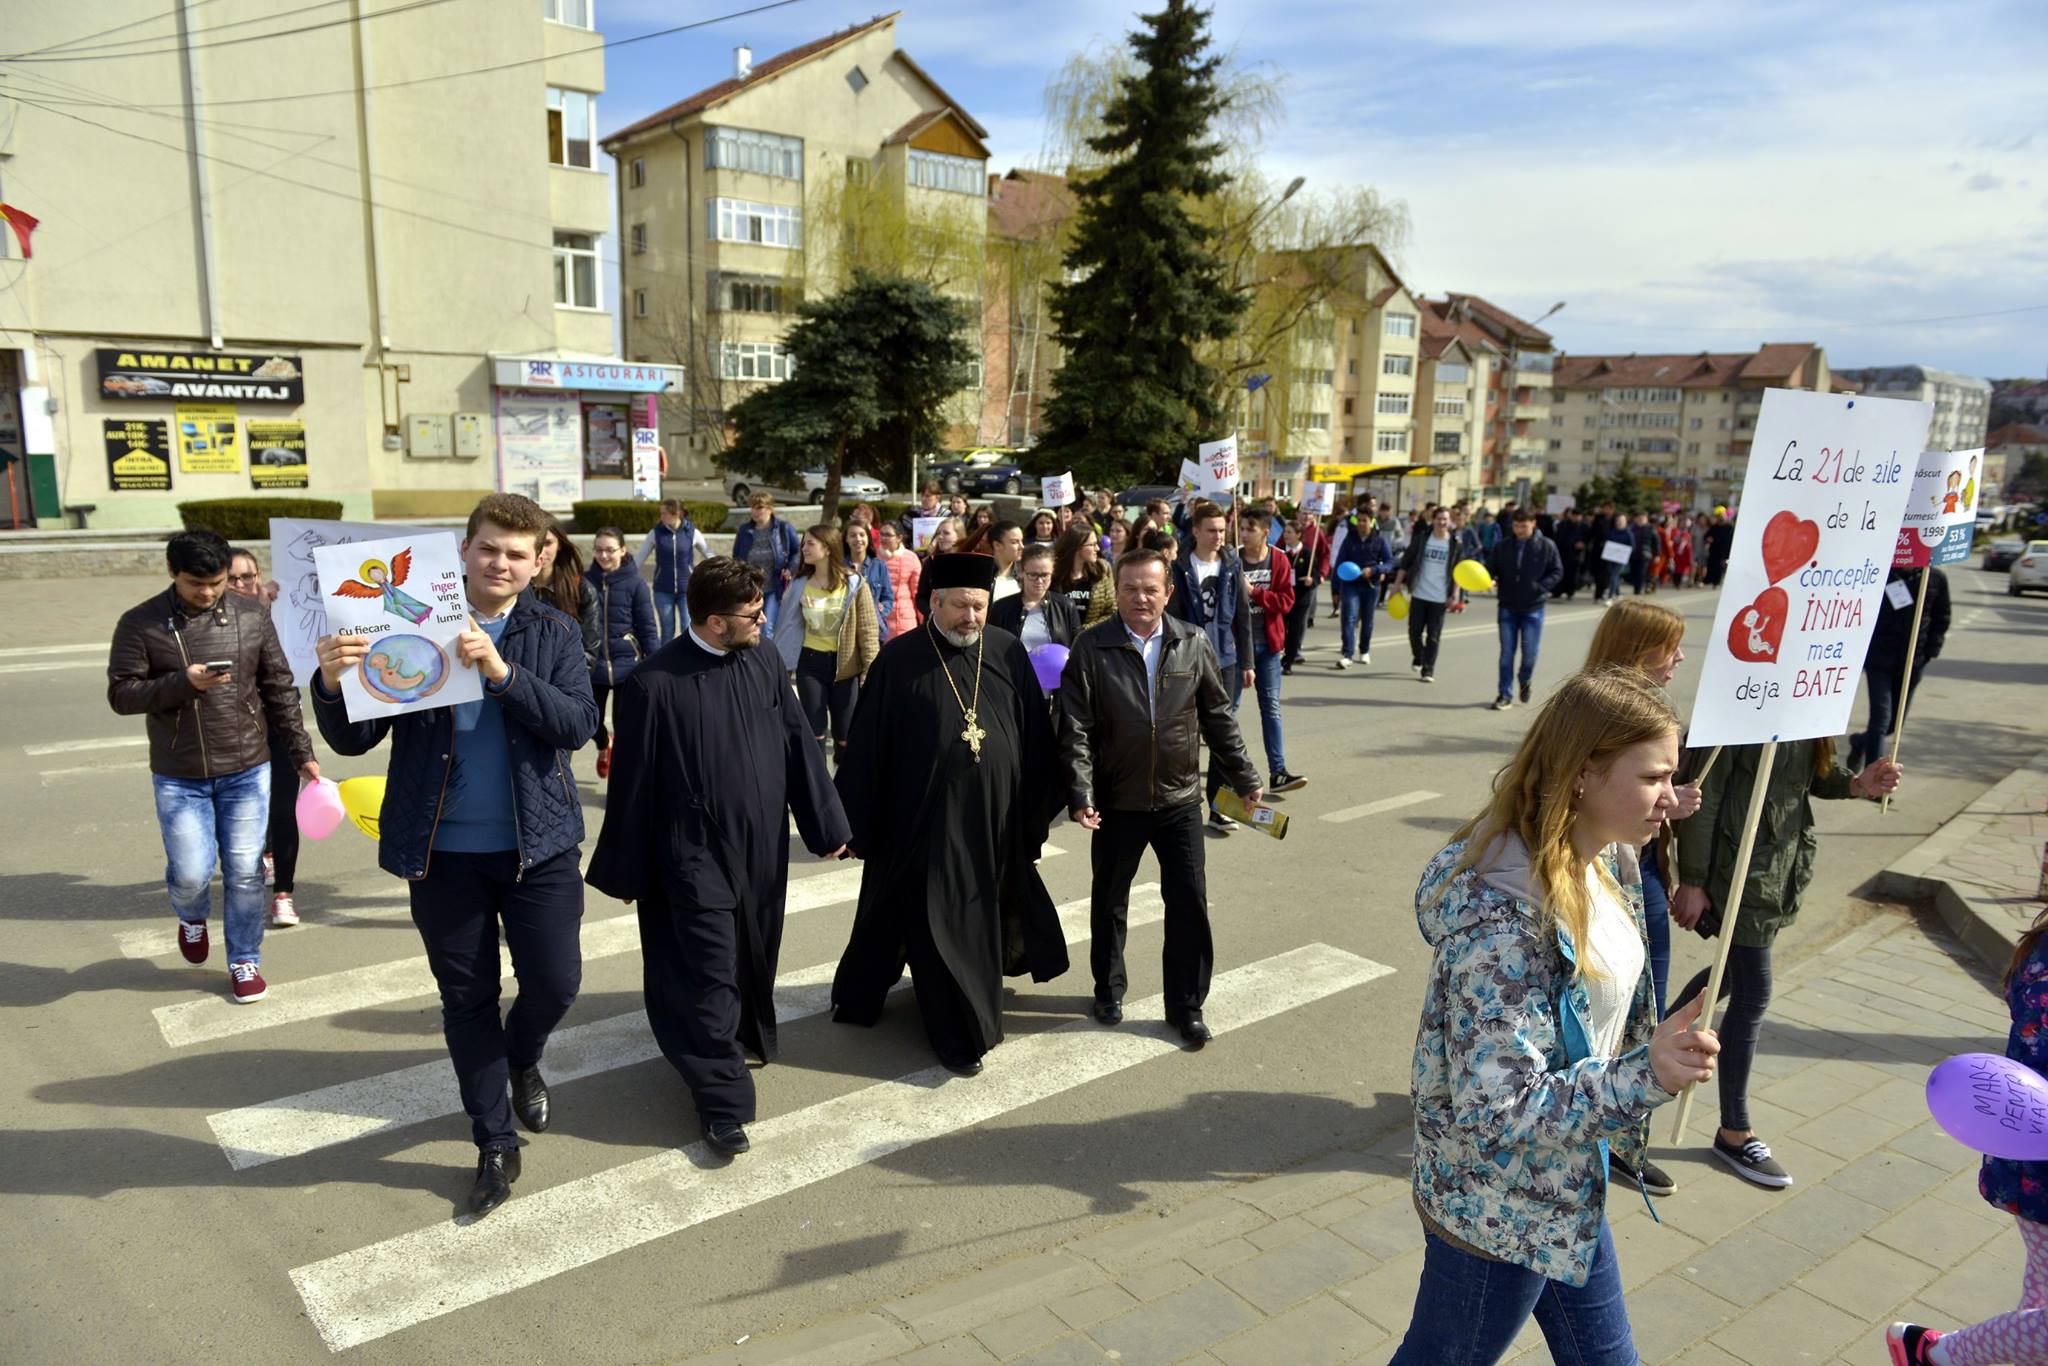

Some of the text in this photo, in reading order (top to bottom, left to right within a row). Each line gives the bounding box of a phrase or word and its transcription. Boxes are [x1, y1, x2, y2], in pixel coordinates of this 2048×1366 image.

[116, 353, 253, 372] AMANET
[170, 382, 290, 400] AVANTAJ
[250, 440, 304, 449] AMANET AUTO
[1773, 440, 1902, 484] La 21 de zile
[1826, 500, 1878, 531] de la
[1922, 526, 1945, 537] 1998
[442, 571, 456, 580] un
[431, 581, 458, 593] înger
[437, 592, 459, 602] vine
[451, 602, 462, 611] în
[1801, 592, 1862, 632] INIMA
[437, 613, 463, 624] lume
[338, 623, 391, 637] Cu fiecare
[1808, 641, 1844, 662] mea
[1736, 667, 1848, 710] deja BATE
